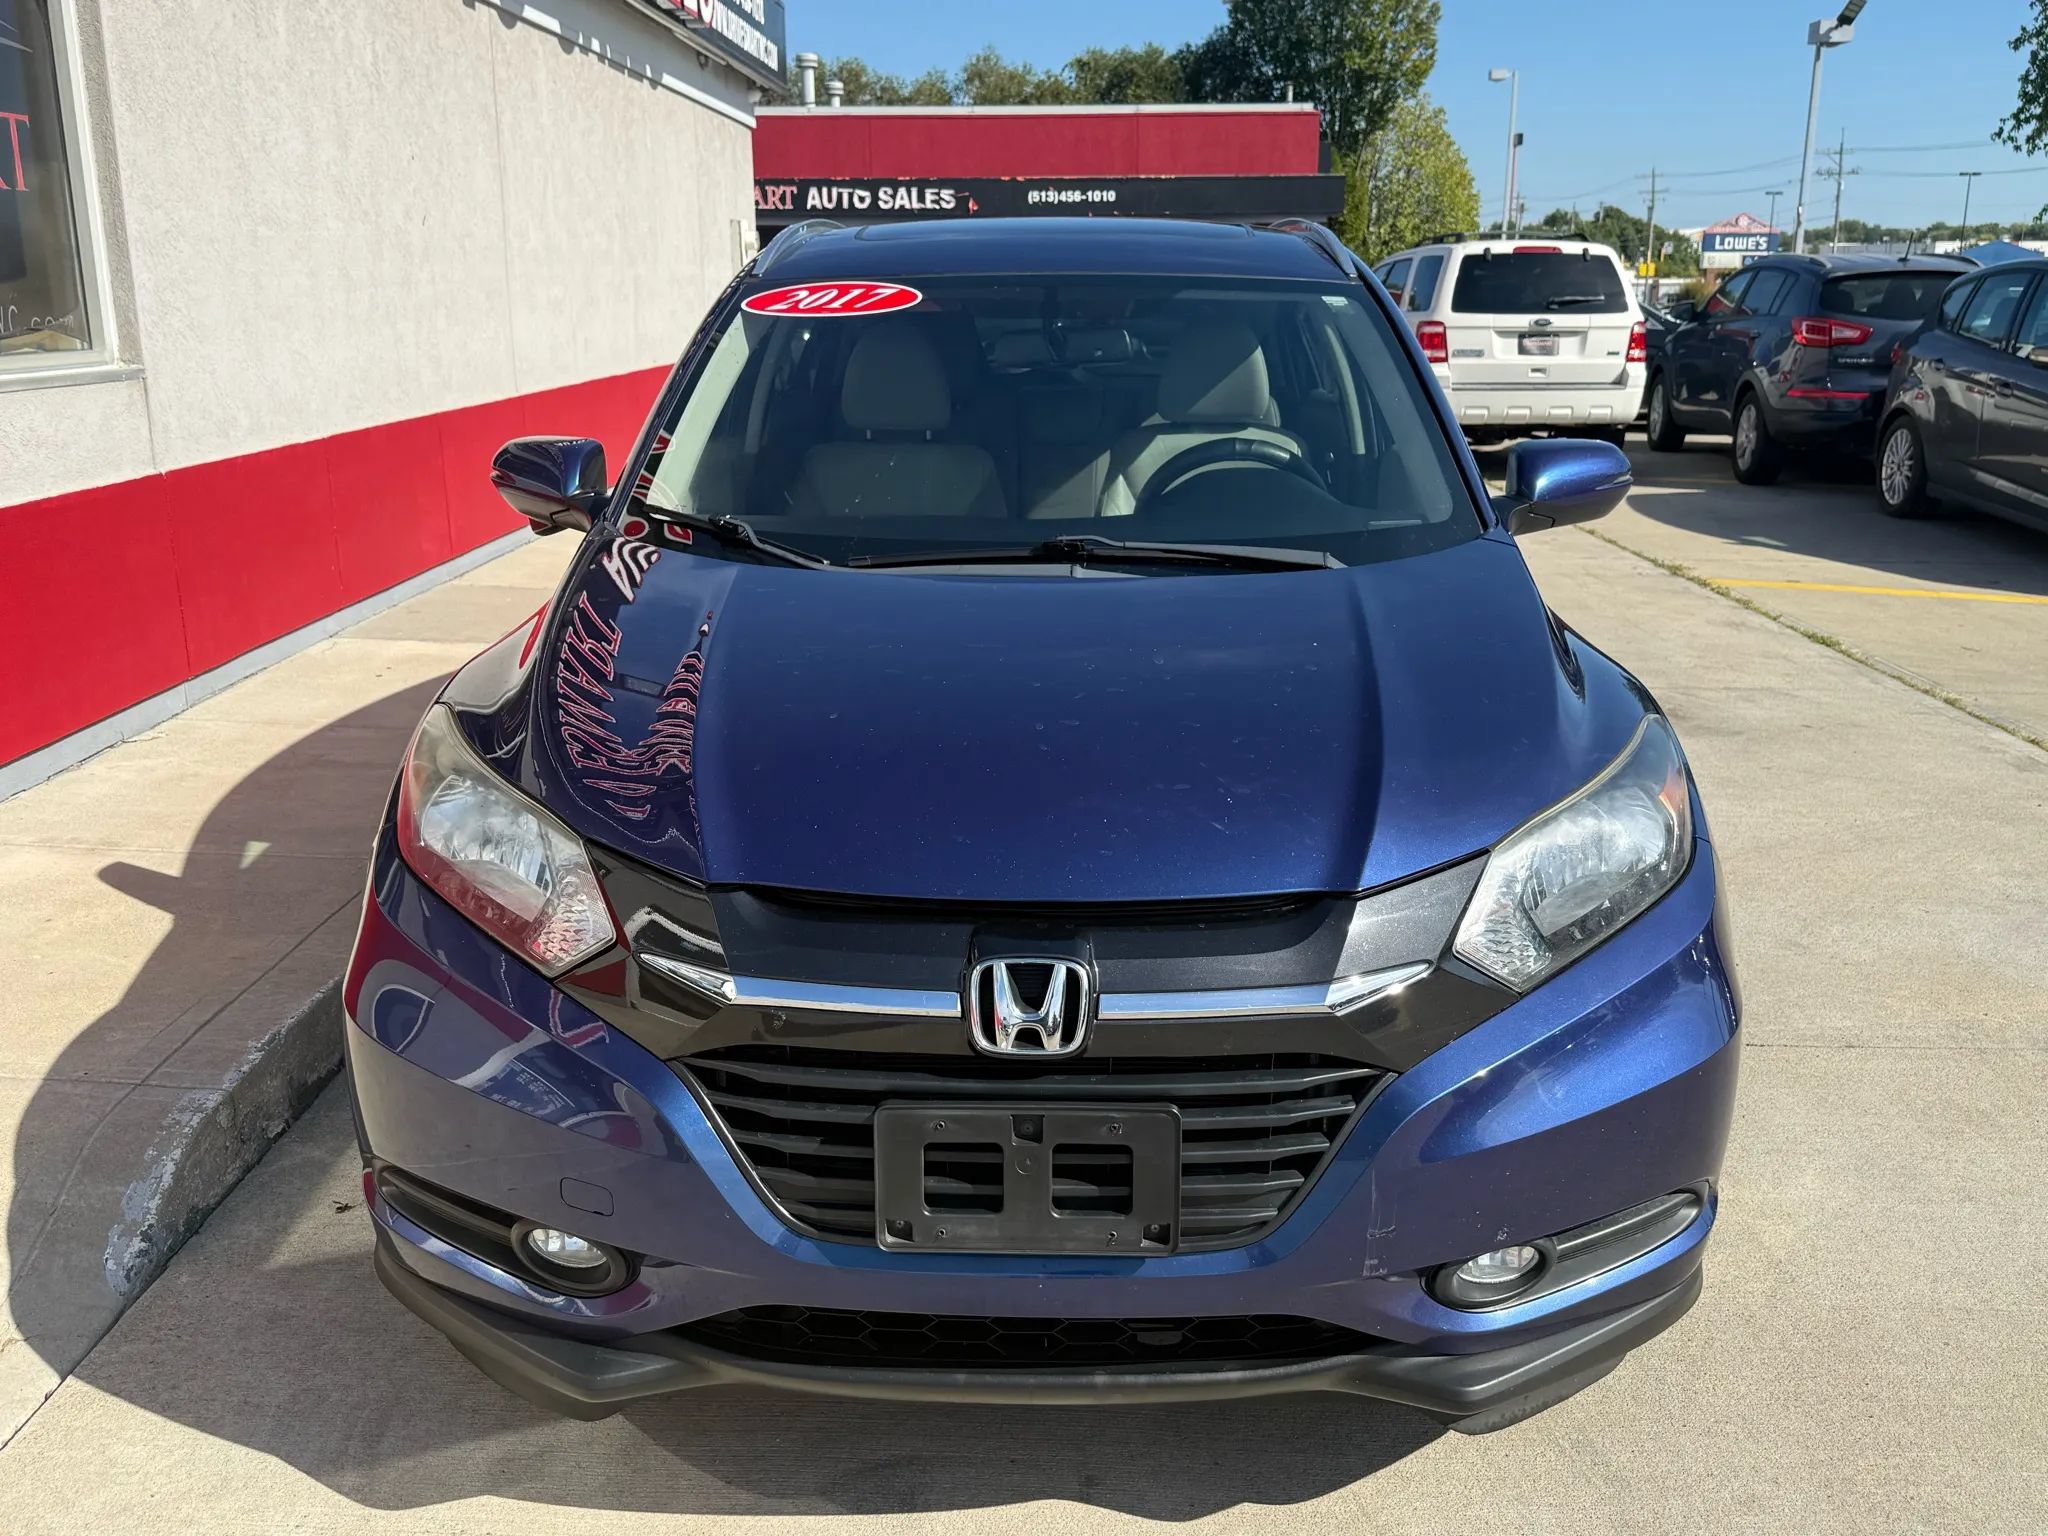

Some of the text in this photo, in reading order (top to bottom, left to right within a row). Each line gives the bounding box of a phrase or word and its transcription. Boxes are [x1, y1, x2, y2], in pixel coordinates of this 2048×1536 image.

[807, 186, 871, 210] AUTO
[878, 187, 957, 210] SALES
[1027, 190, 1117, 205] (513)456-1010
[1714, 234, 1769, 250] LOWE'S
[764, 288, 901, 311] 2017
